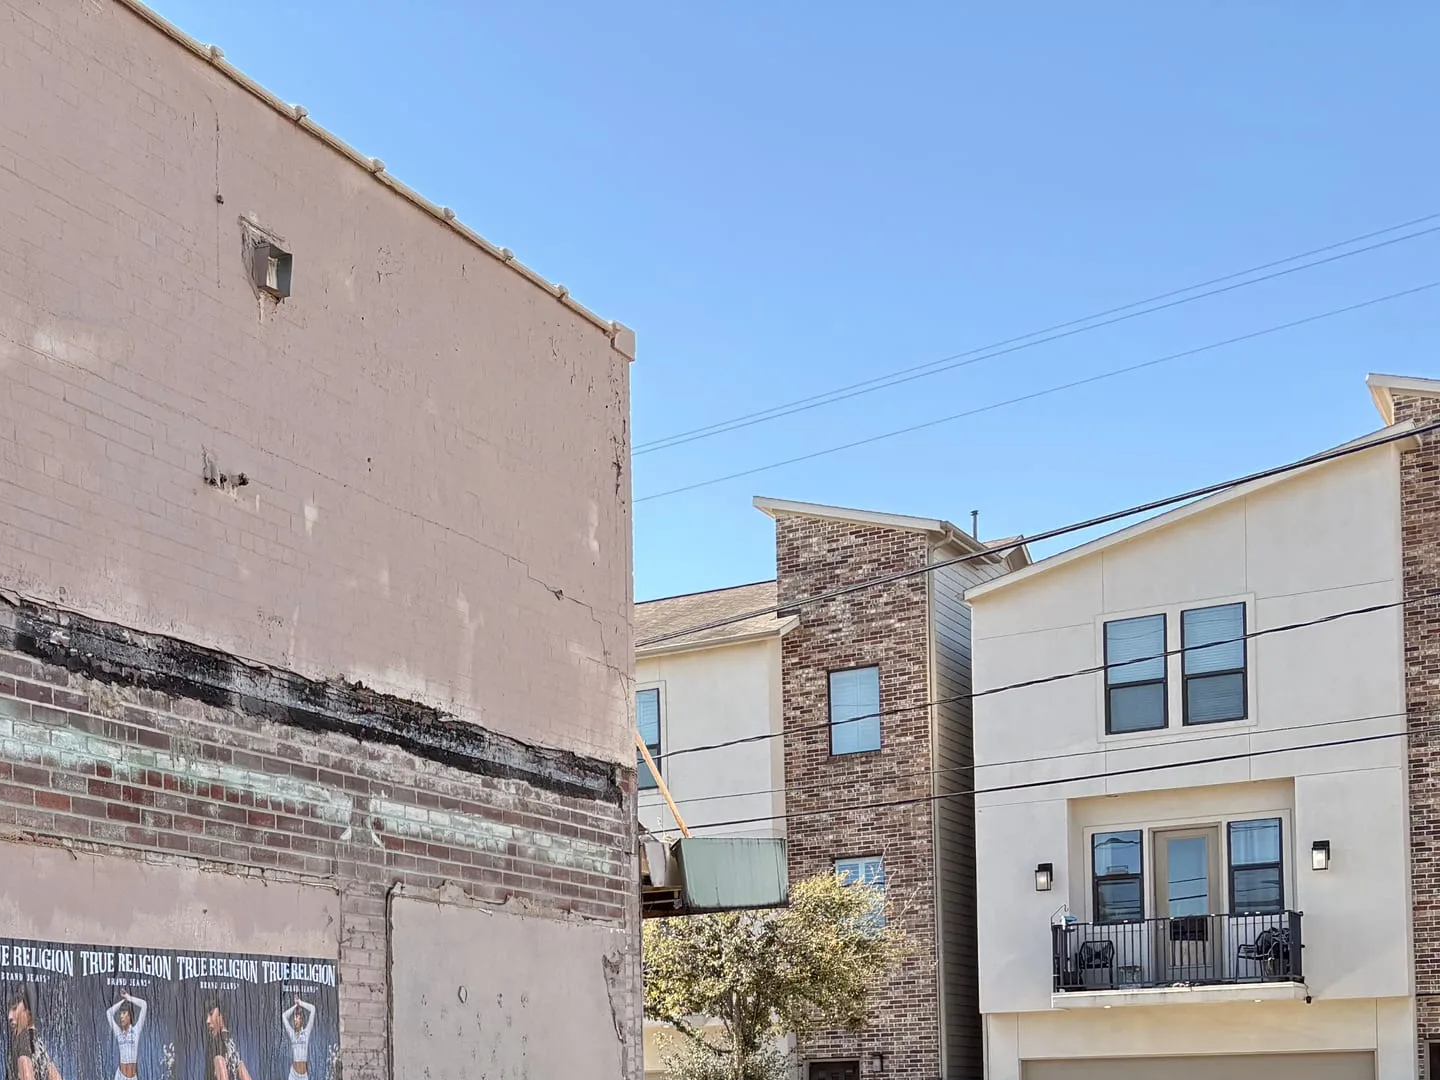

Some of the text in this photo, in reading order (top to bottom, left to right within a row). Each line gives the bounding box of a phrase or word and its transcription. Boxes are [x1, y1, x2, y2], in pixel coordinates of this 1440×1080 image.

[13, 946, 72, 976] RELIGION
[80, 951, 170, 980] TRUE RELIGION
[177, 957, 257, 983] TRUE RELIGION
[262, 962, 334, 986] TRUE RELIGION
